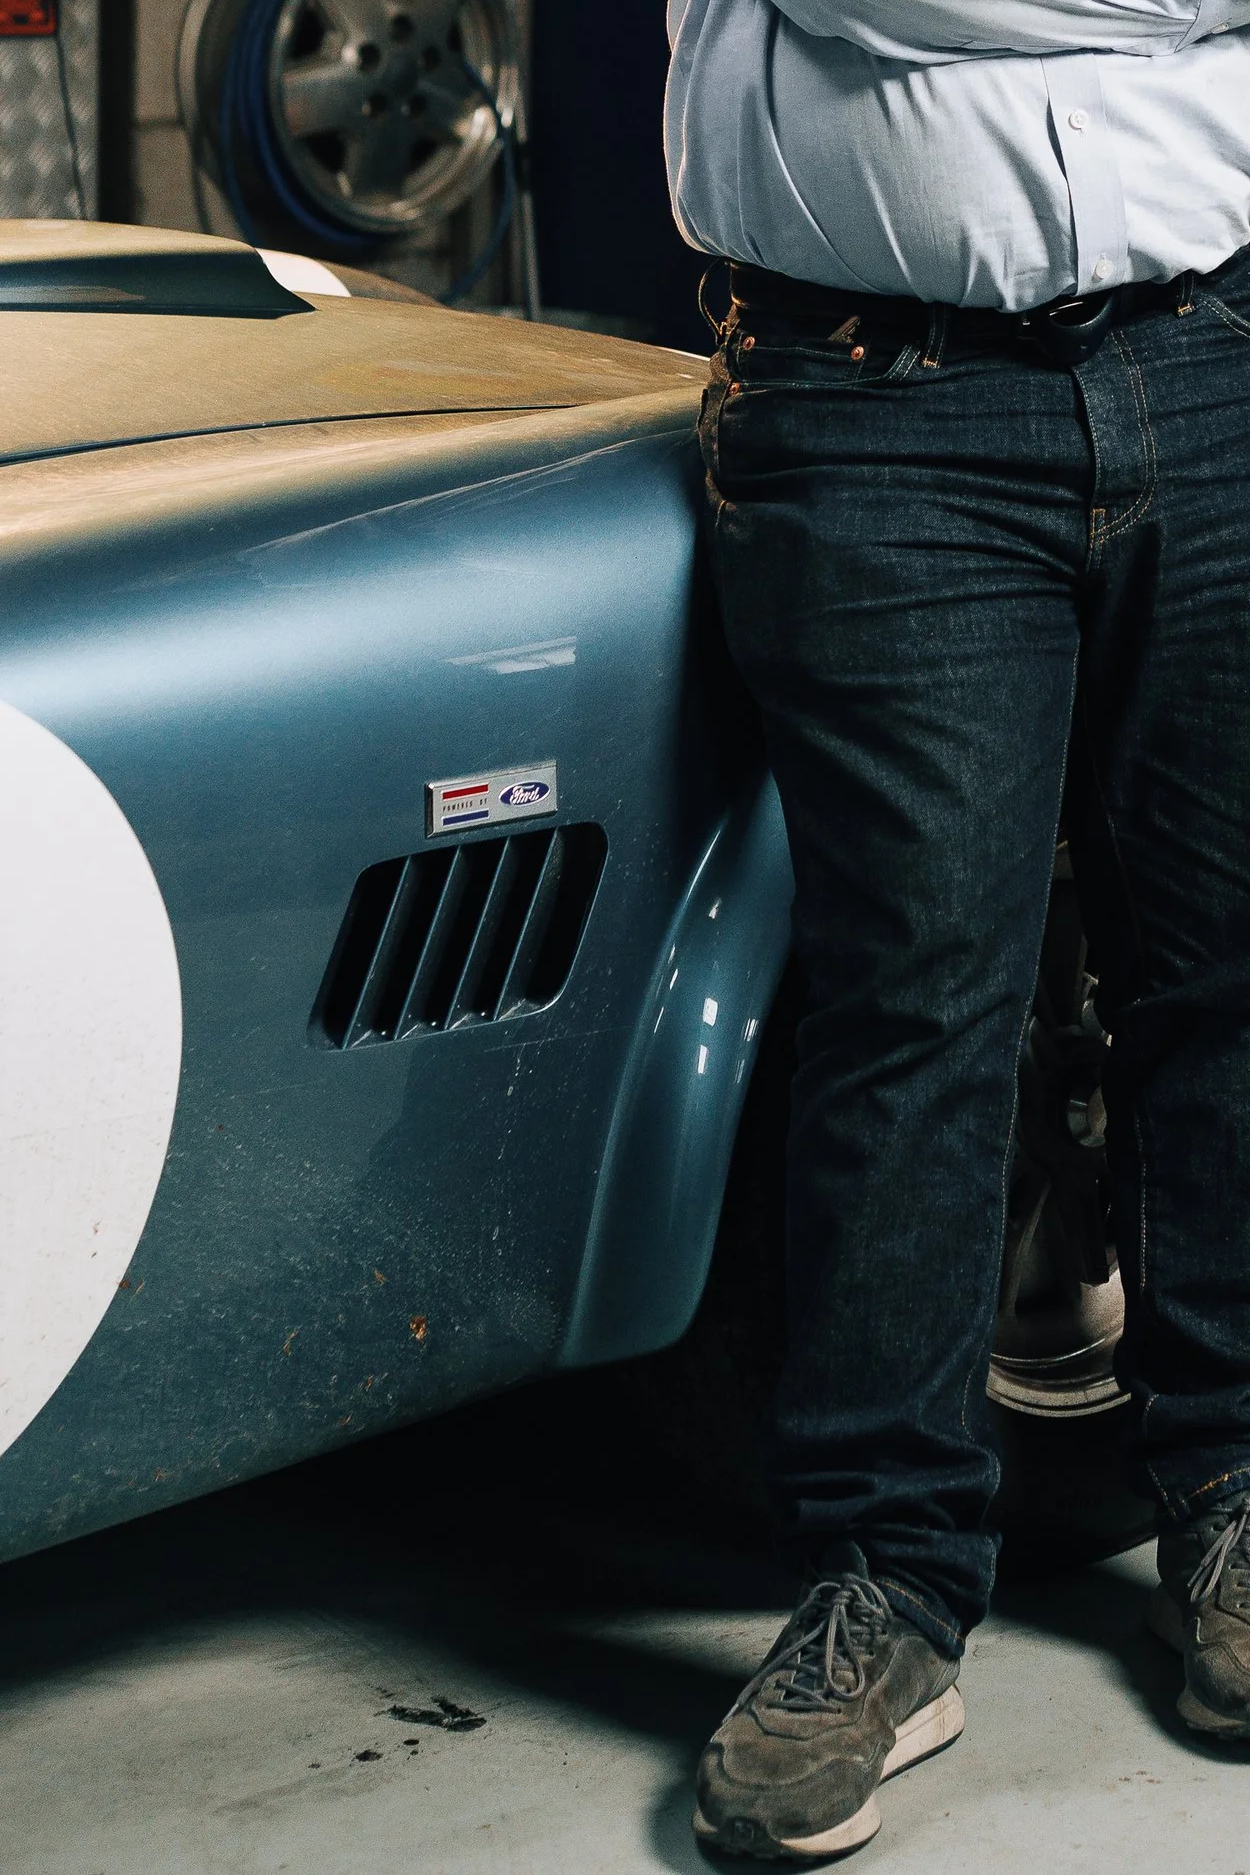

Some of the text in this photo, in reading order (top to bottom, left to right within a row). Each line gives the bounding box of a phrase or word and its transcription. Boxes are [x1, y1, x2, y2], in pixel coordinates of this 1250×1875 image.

[510, 784, 541, 806] Ford
[442, 797, 488, 812] POWERED BY
